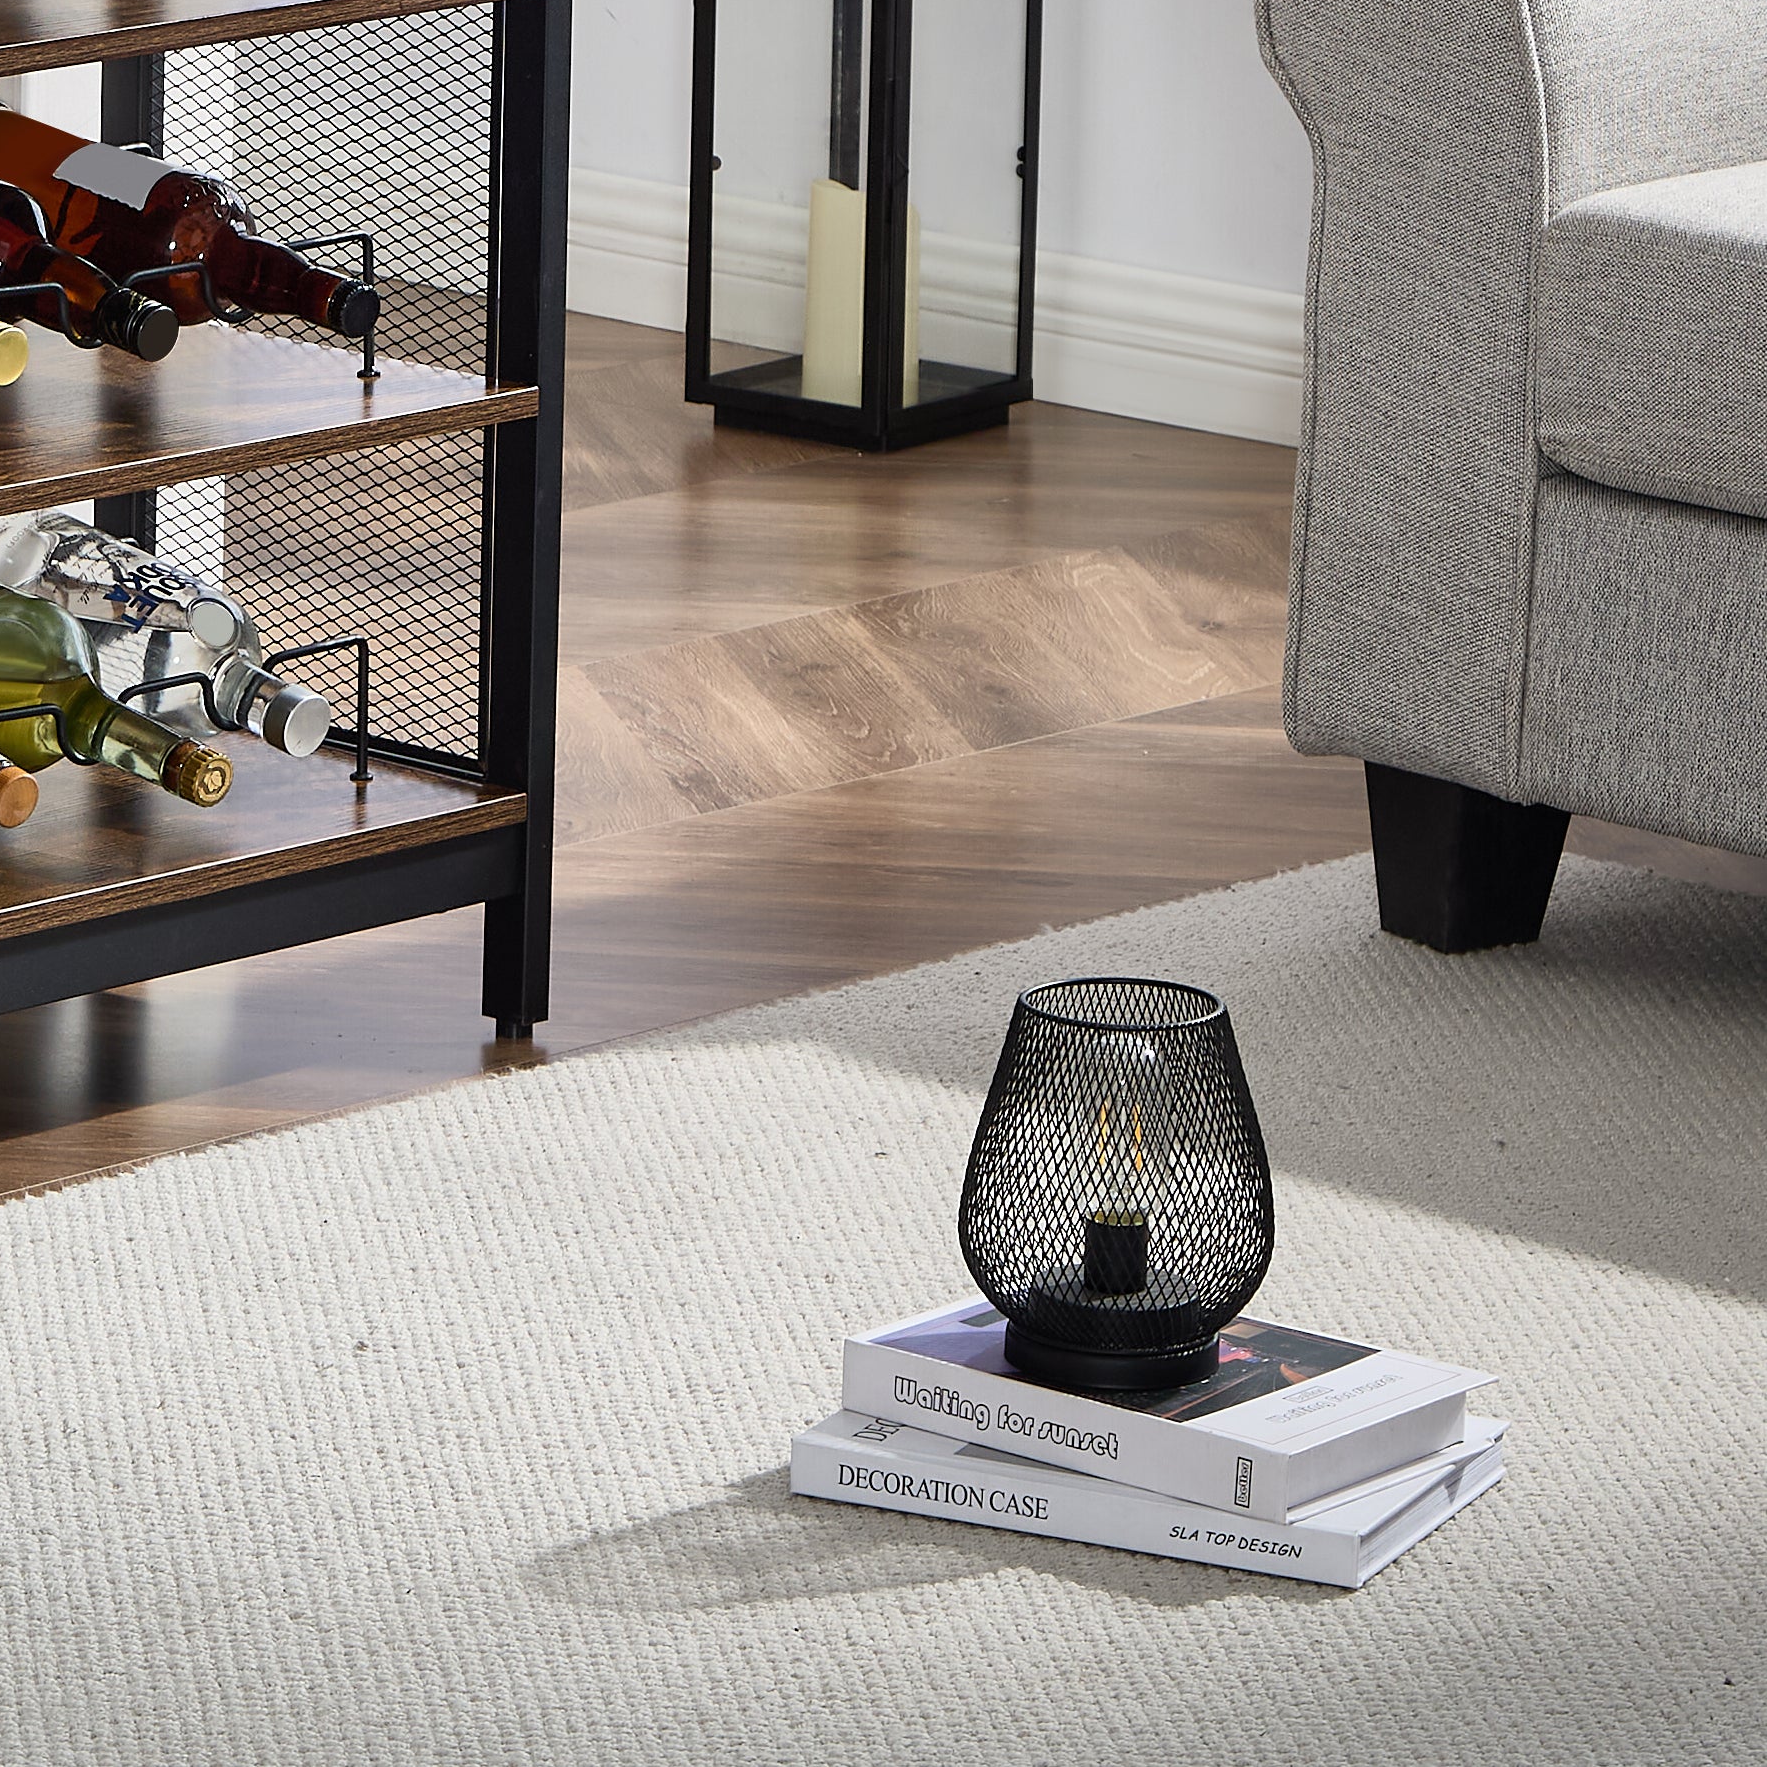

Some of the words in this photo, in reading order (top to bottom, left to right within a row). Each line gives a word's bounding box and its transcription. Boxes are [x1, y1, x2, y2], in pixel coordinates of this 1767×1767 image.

[894, 1375, 990, 1431] Waiting
[997, 1405, 1034, 1437] for
[1038, 1422, 1119, 1461] sunset
[838, 1463, 984, 1509] DECORATION
[989, 1490, 1049, 1521] CASE
[1169, 1526, 1199, 1542] SLA
[1205, 1530, 1236, 1546] TOP
[1237, 1536, 1303, 1559] DESIGN
